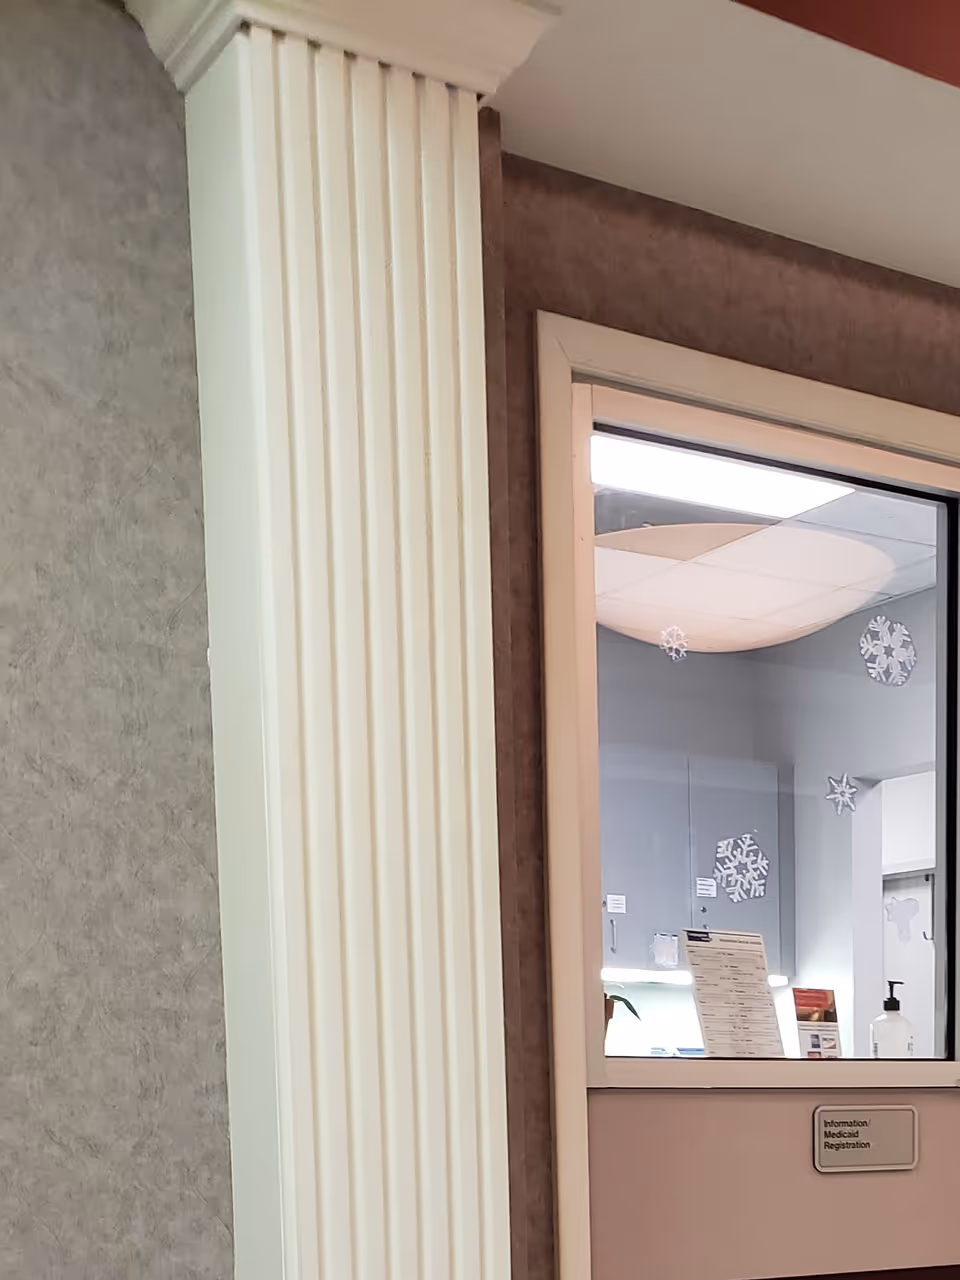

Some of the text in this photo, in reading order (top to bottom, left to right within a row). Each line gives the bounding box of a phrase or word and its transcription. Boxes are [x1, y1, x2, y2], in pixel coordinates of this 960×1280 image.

[824, 1119, 871, 1128] Information/
[824, 1130, 859, 1138] Medicaid
[824, 1141, 870, 1151] Registration
